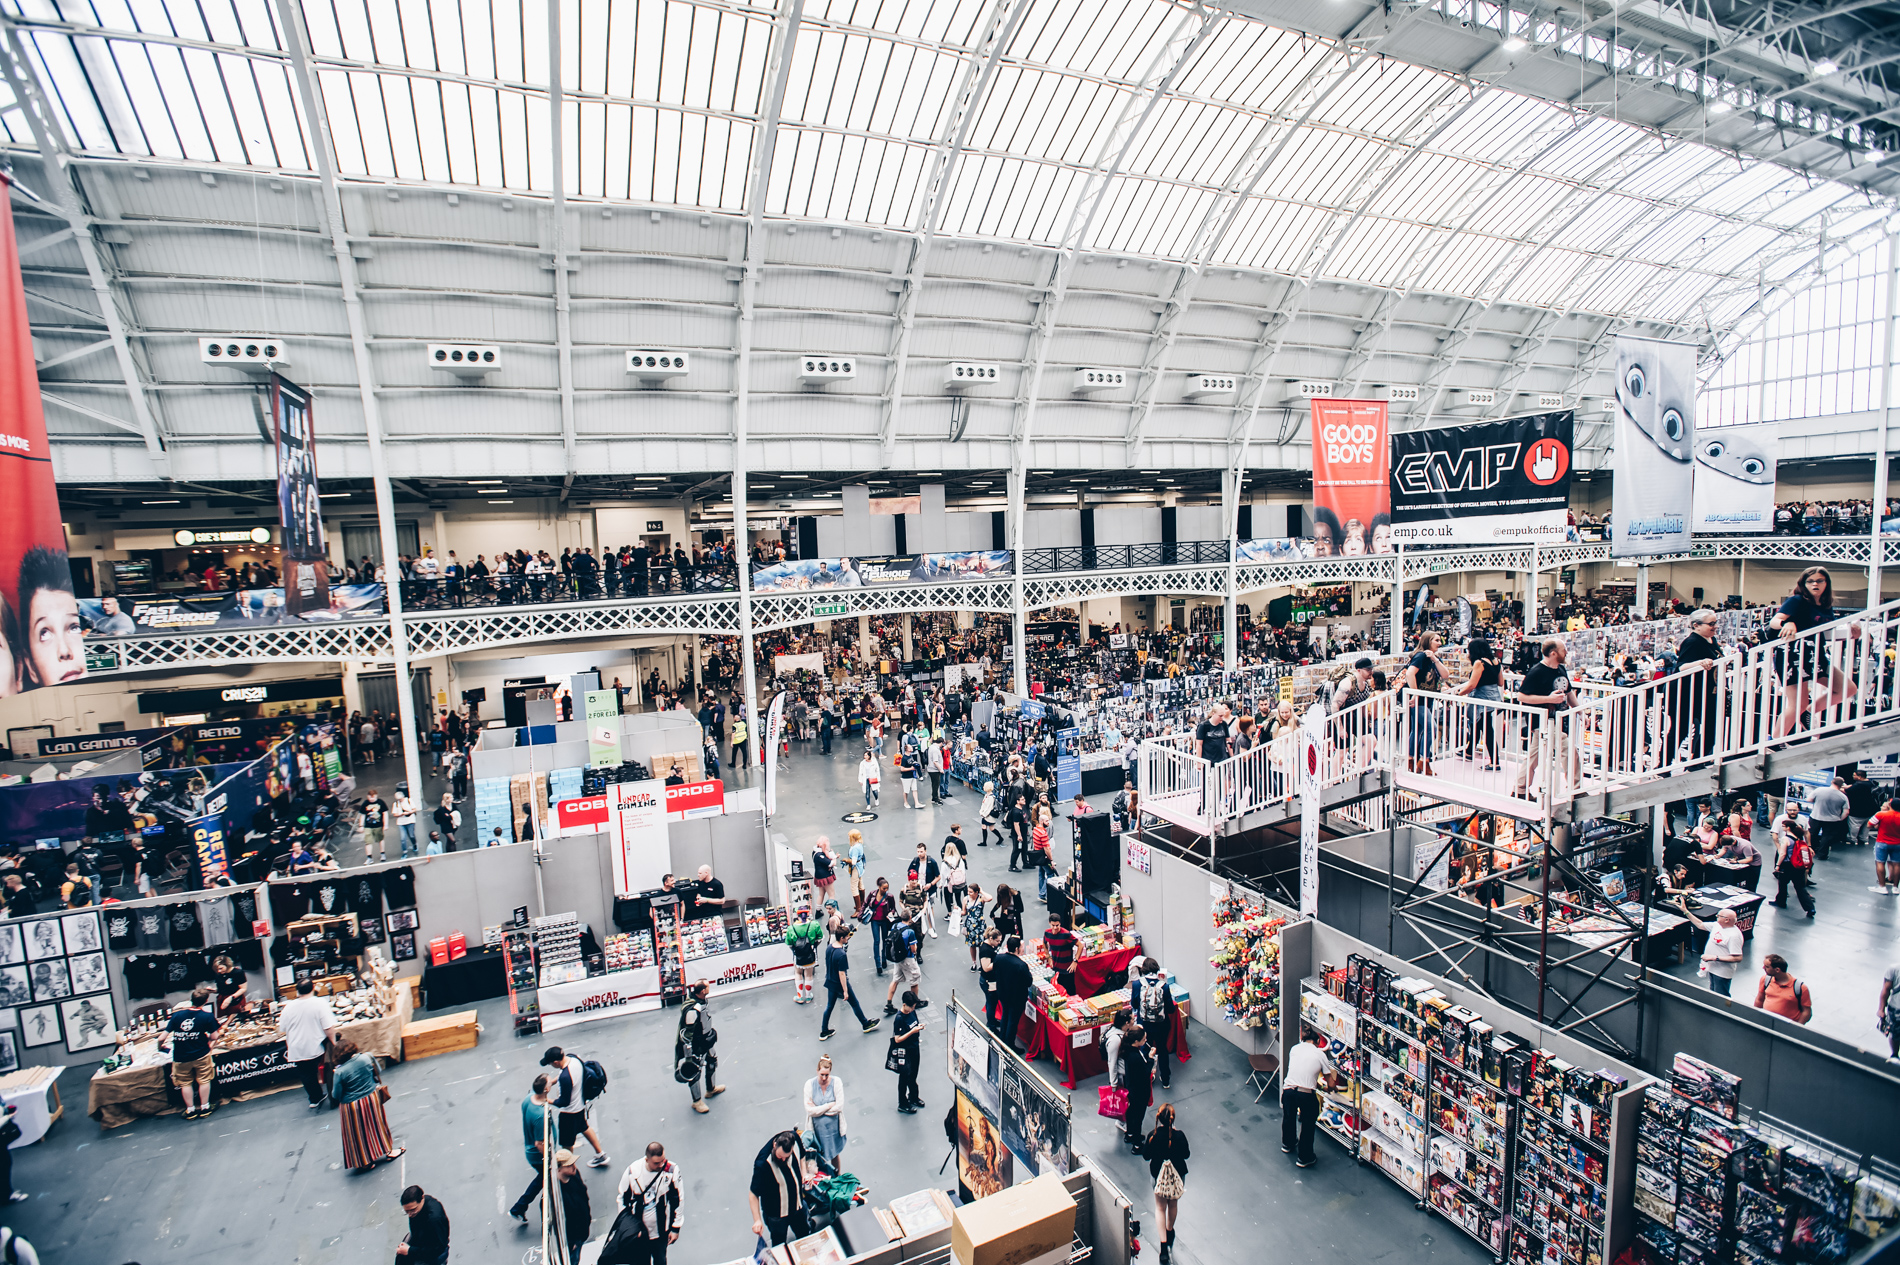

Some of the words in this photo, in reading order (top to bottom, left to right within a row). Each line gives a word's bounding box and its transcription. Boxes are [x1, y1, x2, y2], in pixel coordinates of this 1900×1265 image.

[1323, 424, 1377, 444] GOOD
[1328, 444, 1373, 464] BOYS
[1395, 443, 1521, 494] EMP
[1529, 496, 1566, 504] MERCHANDISE
[1394, 524, 1453, 540] emp.co.uk
[1493, 525, 1566, 538] @empukofficial
[859, 564, 886, 573] FAST
[862, 572, 872, 580] &
[868, 570, 911, 581] FURIOUS
[132, 605, 179, 617] FAST
[137, 616, 150, 625] &
[148, 612, 221, 626] FURIOUS
[606, 710, 616, 718] £10
[198, 726, 241, 739] RETRO
[45, 742, 75, 754] LAN
[78, 736, 137, 750] GAMING
[143, 746, 162, 763] RETRO
[622, 794, 650, 804] UNDEAD
[666, 784, 715, 799] ORDS
[617, 799, 657, 811] GAMING
[716, 969, 764, 986] GAMING
[724, 963, 756, 978] UNDEAD
[574, 997, 627, 1014] GAMING
[582, 991, 619, 1006] UNDEAD
[216, 1057, 258, 1076] HORNS
[262, 1052, 280, 1066] OF
[218, 1062, 298, 1084] WWW.HORNSOFODIN.
[1004, 1078, 1020, 1103] JEDI
